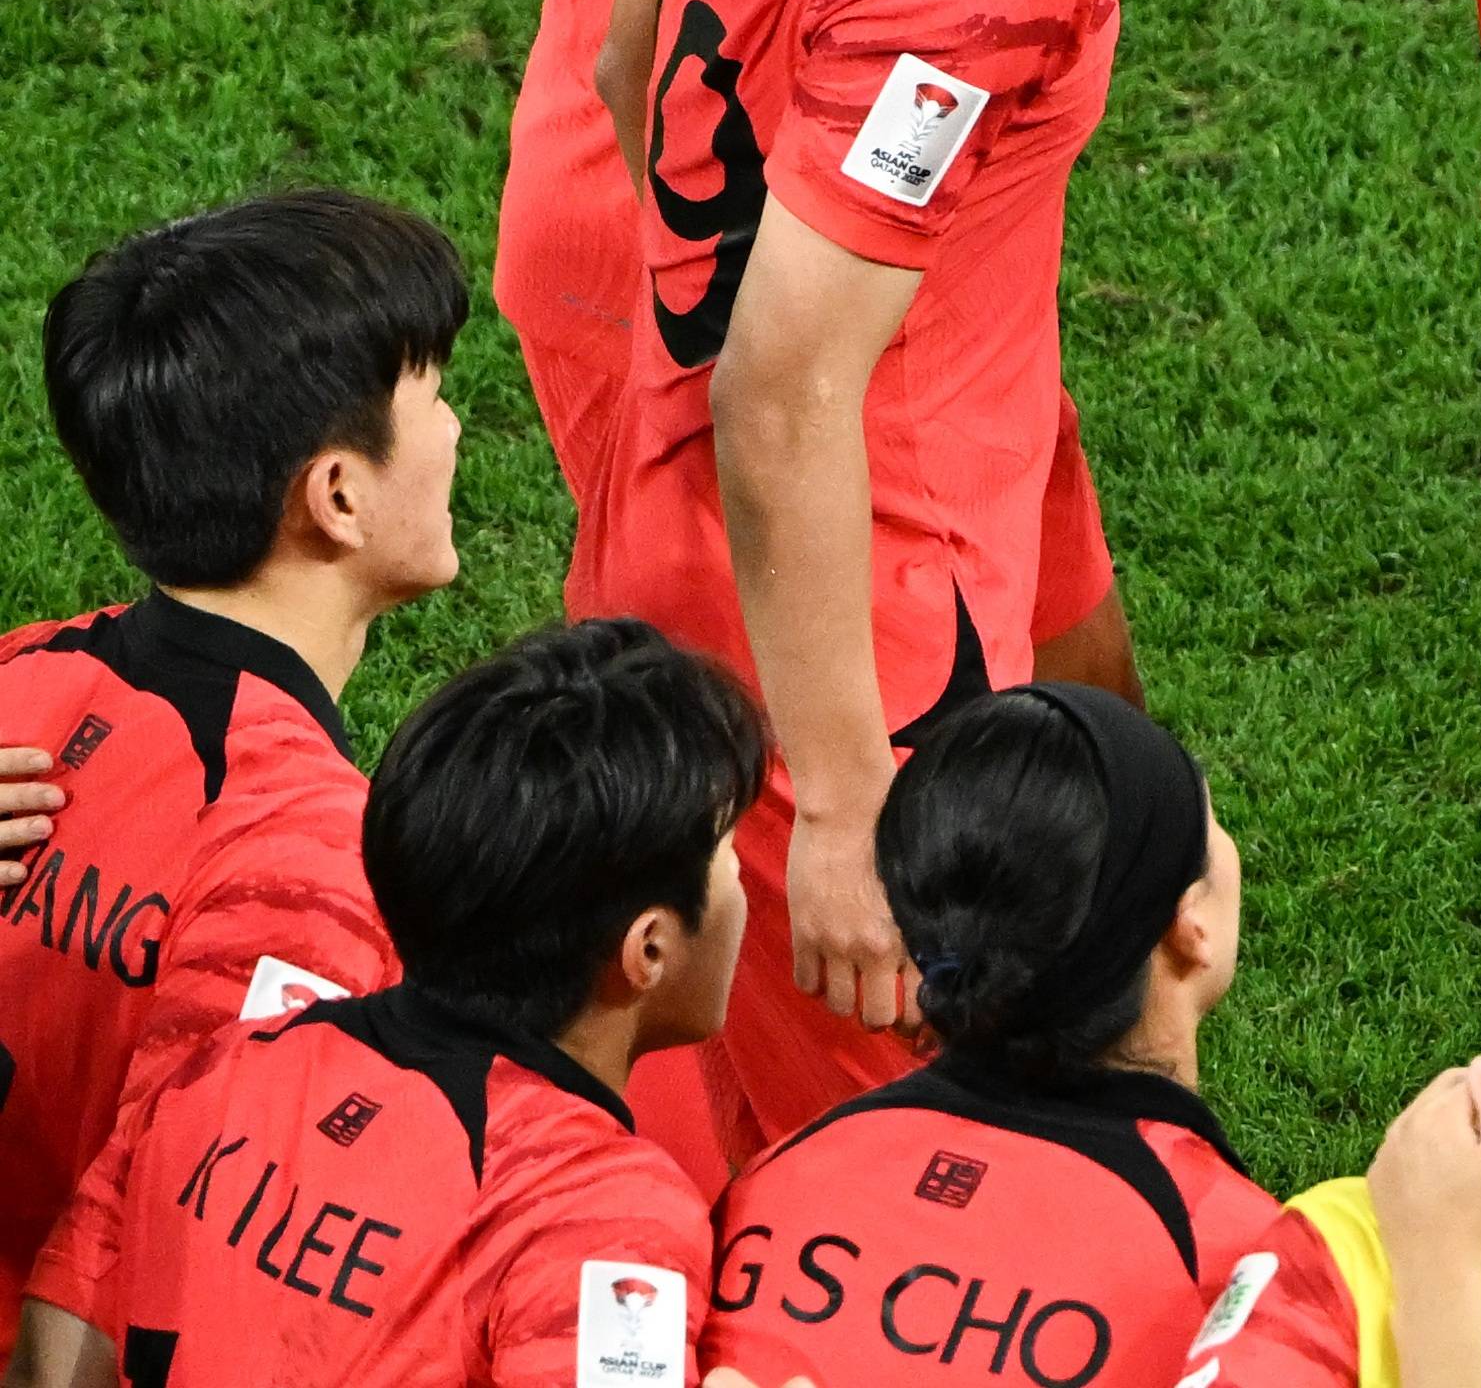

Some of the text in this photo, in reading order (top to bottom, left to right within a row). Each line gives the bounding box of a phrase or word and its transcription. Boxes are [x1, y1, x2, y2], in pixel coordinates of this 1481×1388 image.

[870, 157, 901, 178] QATAR
[871, 147, 931, 178] ASIAN CUP
[897, 150, 916, 162] AFC
[177, 1131, 403, 1320] K I LEE
[711, 1223, 774, 1313] G
[780, 1232, 862, 1324] S
[880, 1262, 1113, 1388] CHO
